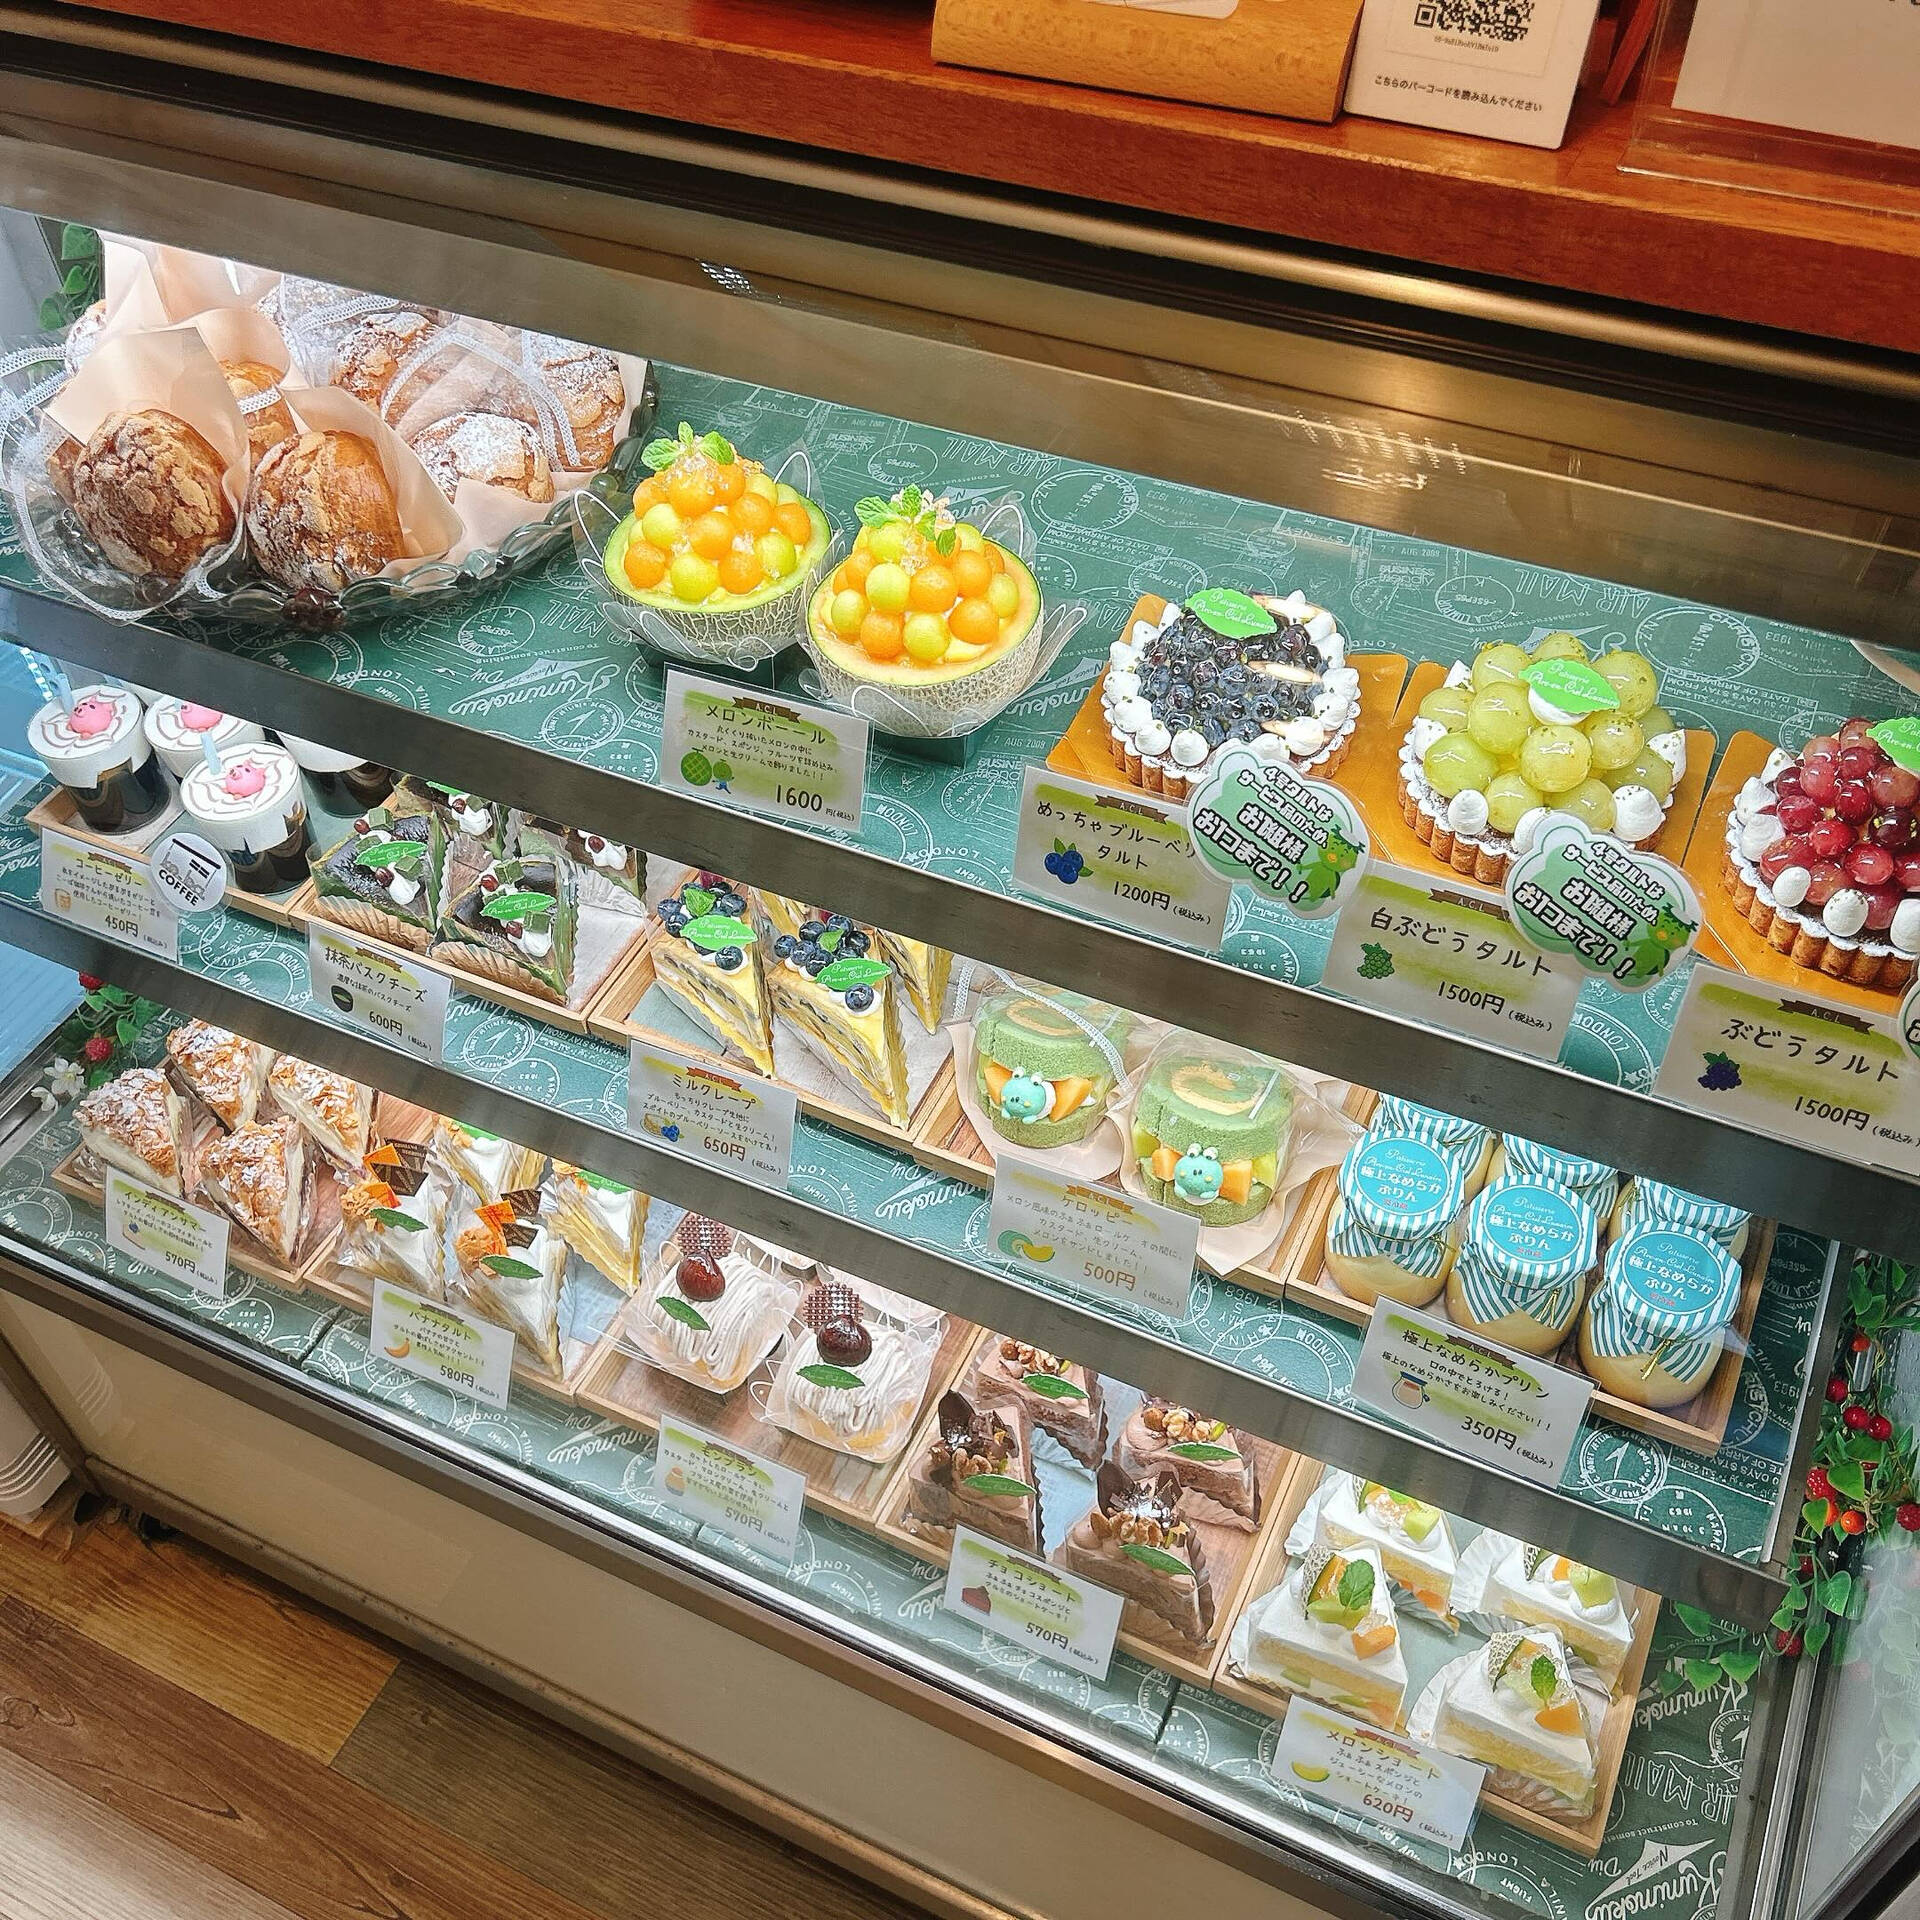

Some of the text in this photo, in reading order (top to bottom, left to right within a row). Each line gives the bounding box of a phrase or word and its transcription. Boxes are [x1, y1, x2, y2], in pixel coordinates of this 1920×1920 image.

[1373, 74, 1542, 112] こちらのバーコードを読み込んでください
[941, 436, 1008, 470] MAIL
[1514, 568, 1590, 607] MAIL
[539, 599, 607, 638] MAIL
[776, 784, 823, 812] 1600
[1264, 766, 1334, 822] 4号タルトは
[76, 857, 143, 887] コーヒーゼリー
[1097, 844, 1149, 870] タルト
[1591, 841, 1666, 901] 4号タルトは
[158, 869, 200, 907] COFFEE
[1113, 880, 1171, 911] 1200円
[104, 914, 139, 938] 450円
[1370, 906, 1552, 977] 白ぶどうタルト
[325, 946, 427, 1003] 抹茶バスクチーズ
[1437, 980, 1505, 1015] 1500円
[369, 1010, 403, 1037] 600円
[1720, 1018, 1899, 1083] ぶどうタルト
[672, 1073, 757, 1110] ミルクレープ
[1794, 1095, 1871, 1132] 1500円
[703, 1136, 746, 1163] 650円
[125, 1191, 206, 1232] インディアンサマー
[1061, 1195, 1133, 1225] ケロッピー
[165, 1250, 196, 1274] 570円
[1083, 1261, 1137, 1292] 500円
[409, 1311, 471, 1341] バナナタルト
[440, 1364, 474, 1388] 580円
[1401, 1327, 1550, 1400] 極上なめらかプリン
[1429, 1361, 1510, 1401] 口の中でとろける！
[1460, 1415, 1517, 1451] 350円
[702, 1447, 757, 1477] モンブラン
[725, 1507, 763, 1533] 570円
[987, 1559, 1076, 1603] チョコショート
[1025, 1622, 1069, 1650] 570円
[1326, 1730, 1441, 1780] メロンショート
[1363, 1793, 1414, 1824] 620円
[1498, 1877, 1533, 1903] FLIGHT
